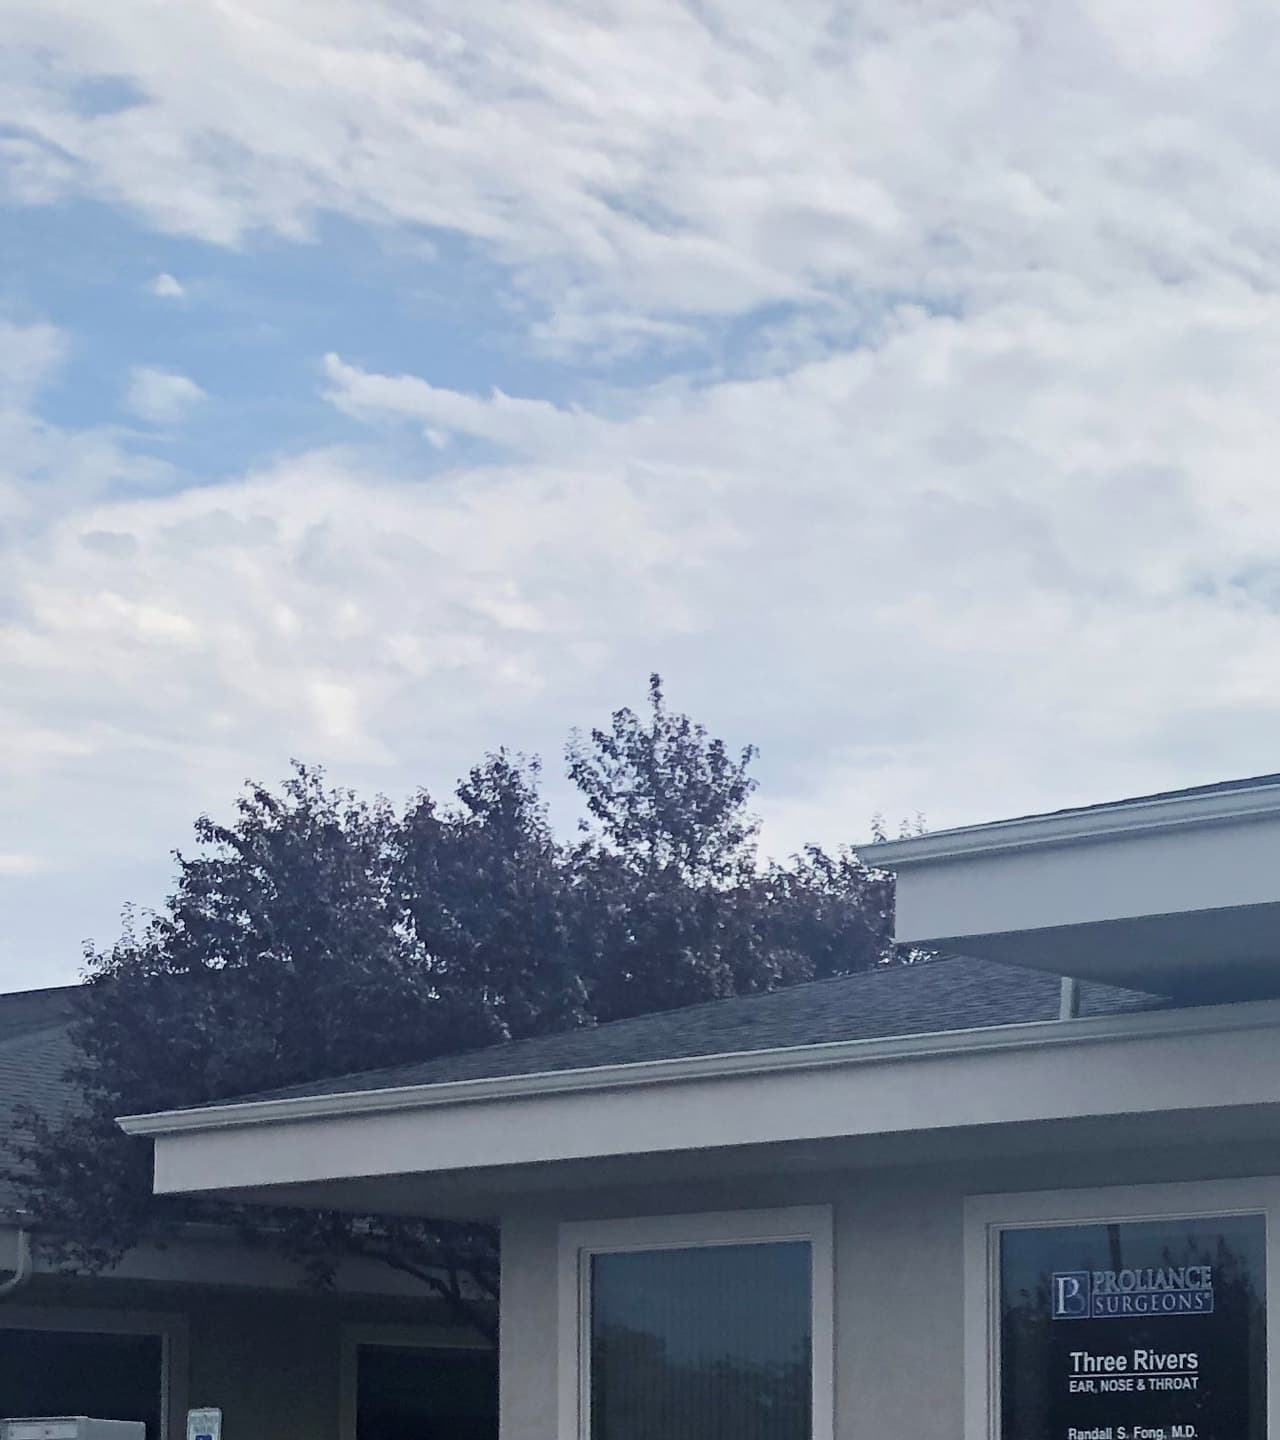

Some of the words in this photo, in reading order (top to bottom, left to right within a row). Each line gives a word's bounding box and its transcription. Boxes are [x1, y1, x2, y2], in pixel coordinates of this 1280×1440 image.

[1093, 1266, 1212, 1293] PROLIANCE
[1069, 1351, 1128, 1373] Three
[1133, 1349, 1199, 1371] Rivers
[1069, 1379, 1098, 1394] EAR,
[1100, 1378, 1134, 1392] NOSE
[1136, 1378, 1146, 1391] &
[1148, 1377, 1199, 1390] THROAT
[1068, 1427, 1113, 1440] Randall
[1117, 1426, 1129, 1439] S.
[1133, 1426, 1167, 1440] Fong,
[1171, 1425, 1198, 1438] M.D.
